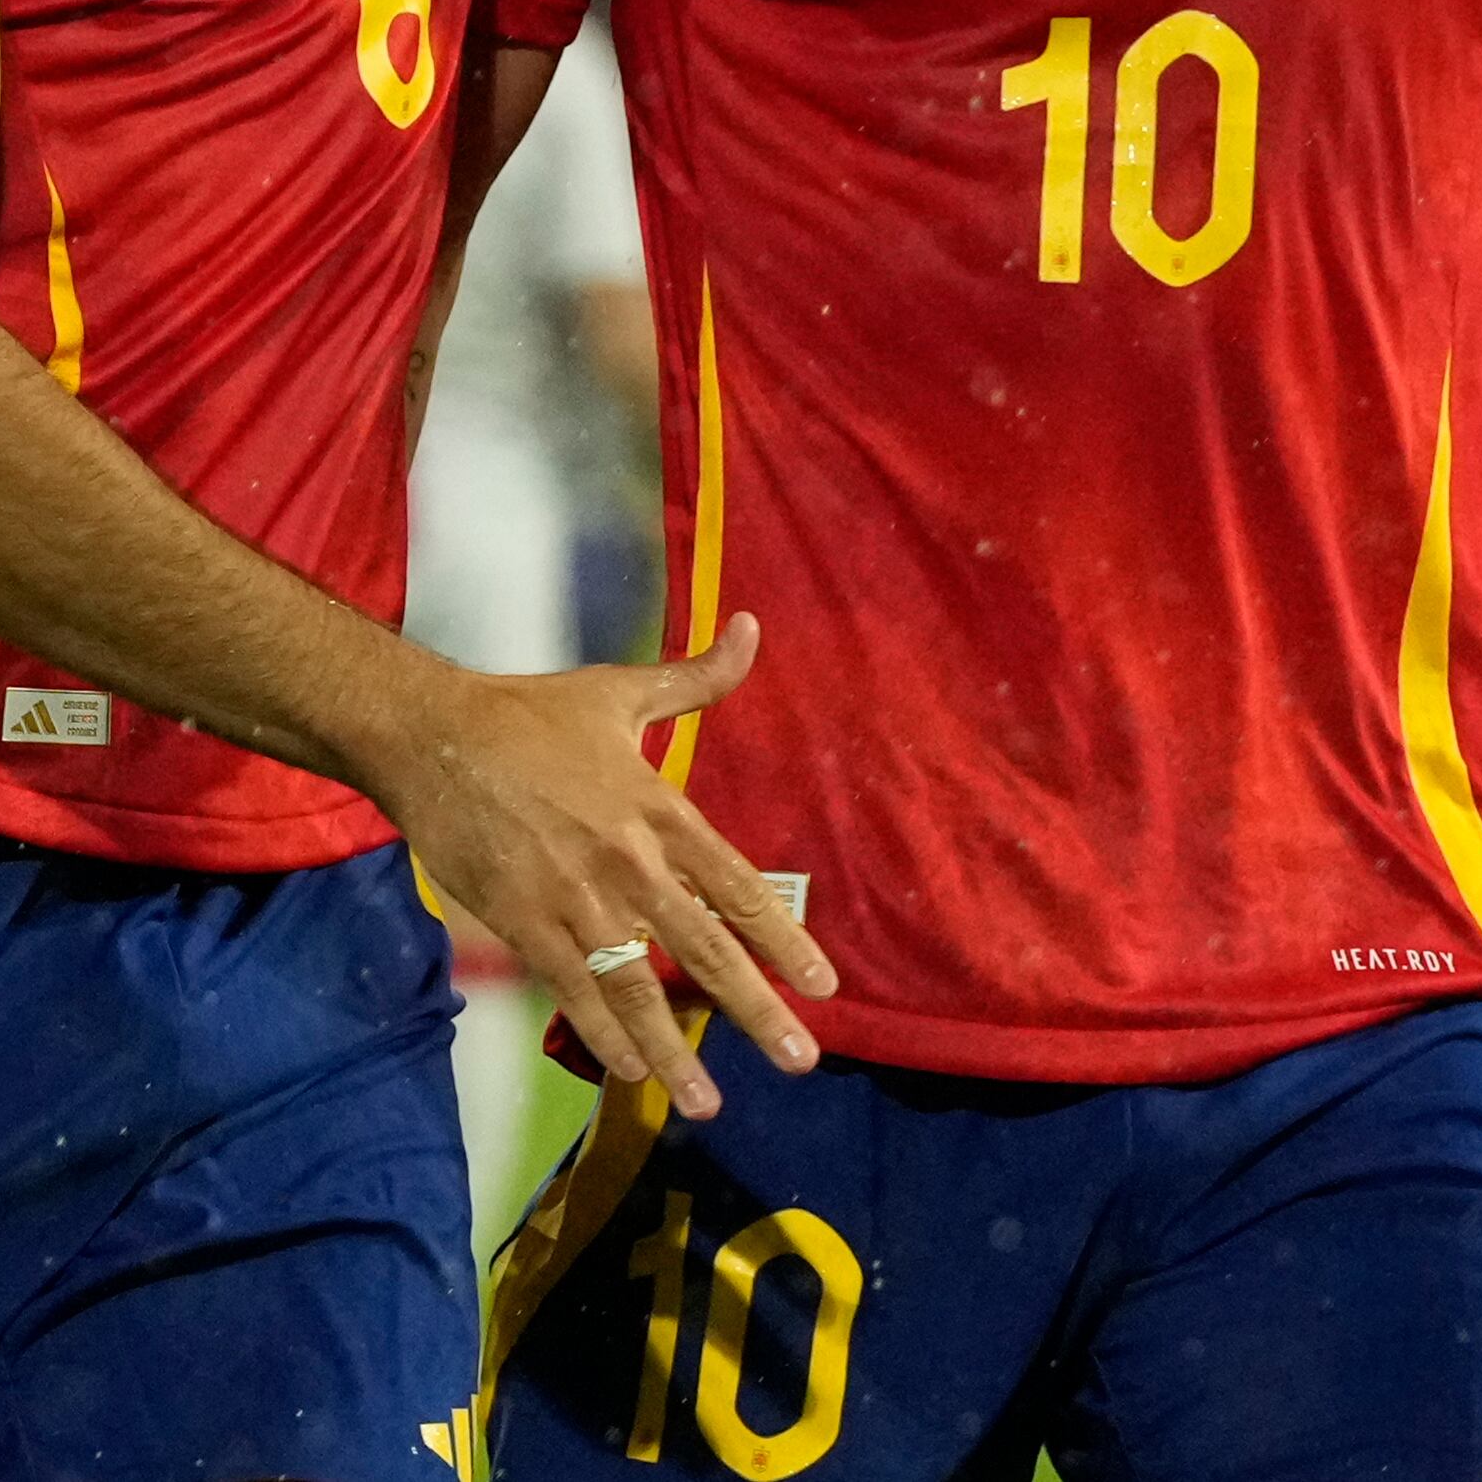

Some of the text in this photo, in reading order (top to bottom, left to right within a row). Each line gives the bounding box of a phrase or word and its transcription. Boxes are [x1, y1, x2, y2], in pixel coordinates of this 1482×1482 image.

[1001, 9, 1259, 287] 10
[1331, 948, 1456, 973] HEAT.RDY
[626, 1190, 864, 1482] 10
